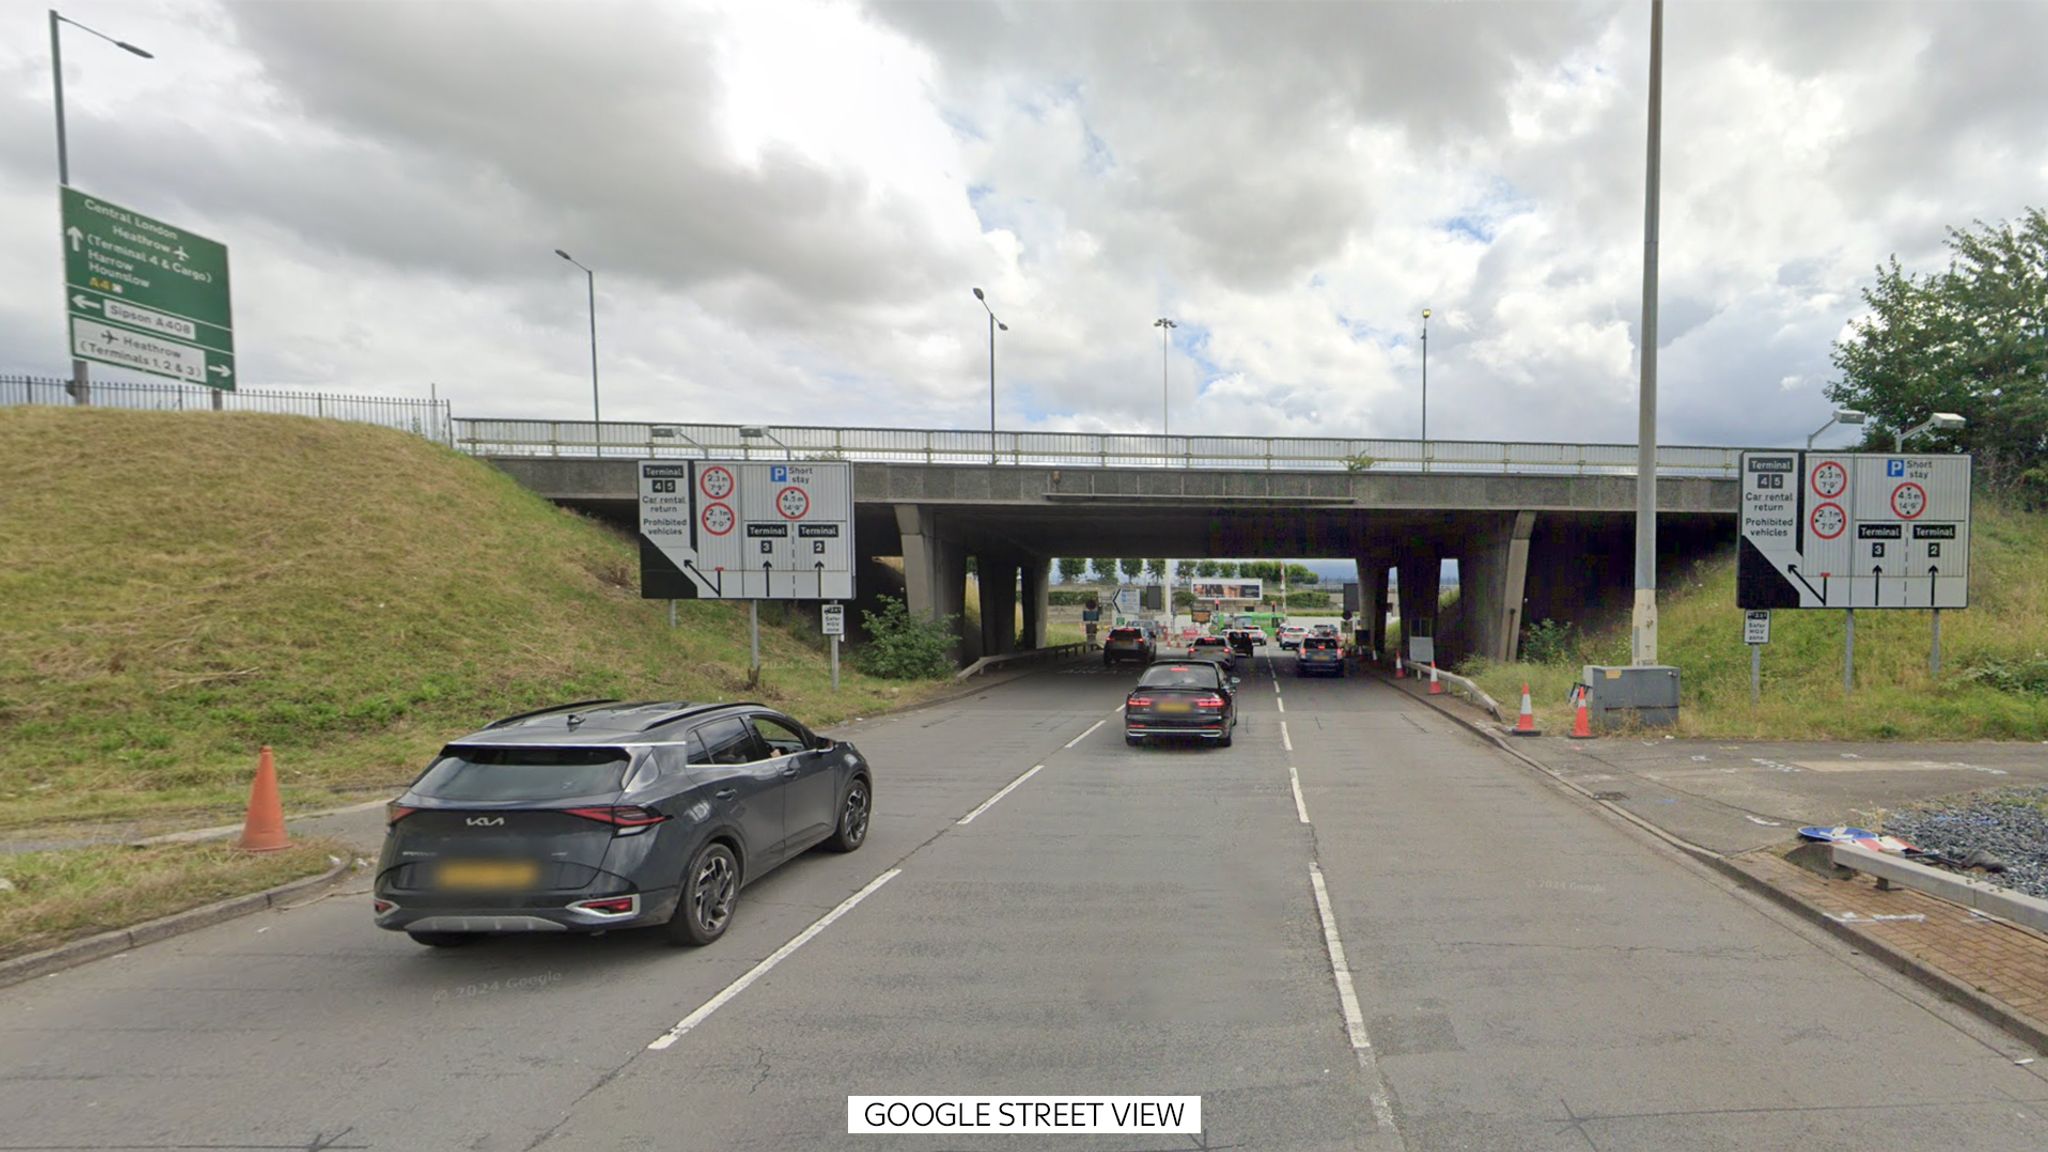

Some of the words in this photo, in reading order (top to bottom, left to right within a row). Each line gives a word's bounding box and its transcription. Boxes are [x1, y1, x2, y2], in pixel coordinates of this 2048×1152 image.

[84, 198, 131, 225] Central
[135, 216, 177, 240] London
[112, 225, 170, 252] Heathrow
[87, 234, 146, 262] (Terminal
[149, 255, 158, 266] 4
[172, 262, 212, 284] Cargo)
[88, 248, 133, 271] Harrow
[88, 261, 150, 288] Hounslow
[90, 277, 111, 291] A4
[110, 304, 152, 324] Sipson
[155, 318, 191, 335] A408
[123, 336, 181, 359] Heathrow
[1751, 460, 1790, 470] Terminal
[1891, 461, 1902, 475] P
[1907, 460, 1932, 468] Short
[645, 466, 682, 476] Terminal
[774, 468, 784, 480] P
[788, 466, 813, 474] Short
[1909, 471, 1928, 479] stay
[792, 476, 809, 484] stay
[642, 496, 657, 504] Car
[660, 496, 686, 504] rental
[1745, 492, 1762, 501] Car
[1765, 492, 1793, 501] rental
[643, 518, 687, 526] Prohibited
[1745, 518, 1793, 526] Prohibited
[749, 527, 785, 535] Terminal
[801, 527, 836, 535] Terminal
[1750, 529, 1788, 537] vehicles
[1861, 527, 1899, 536] Terminal
[1916, 527, 1953, 536] Terminal
